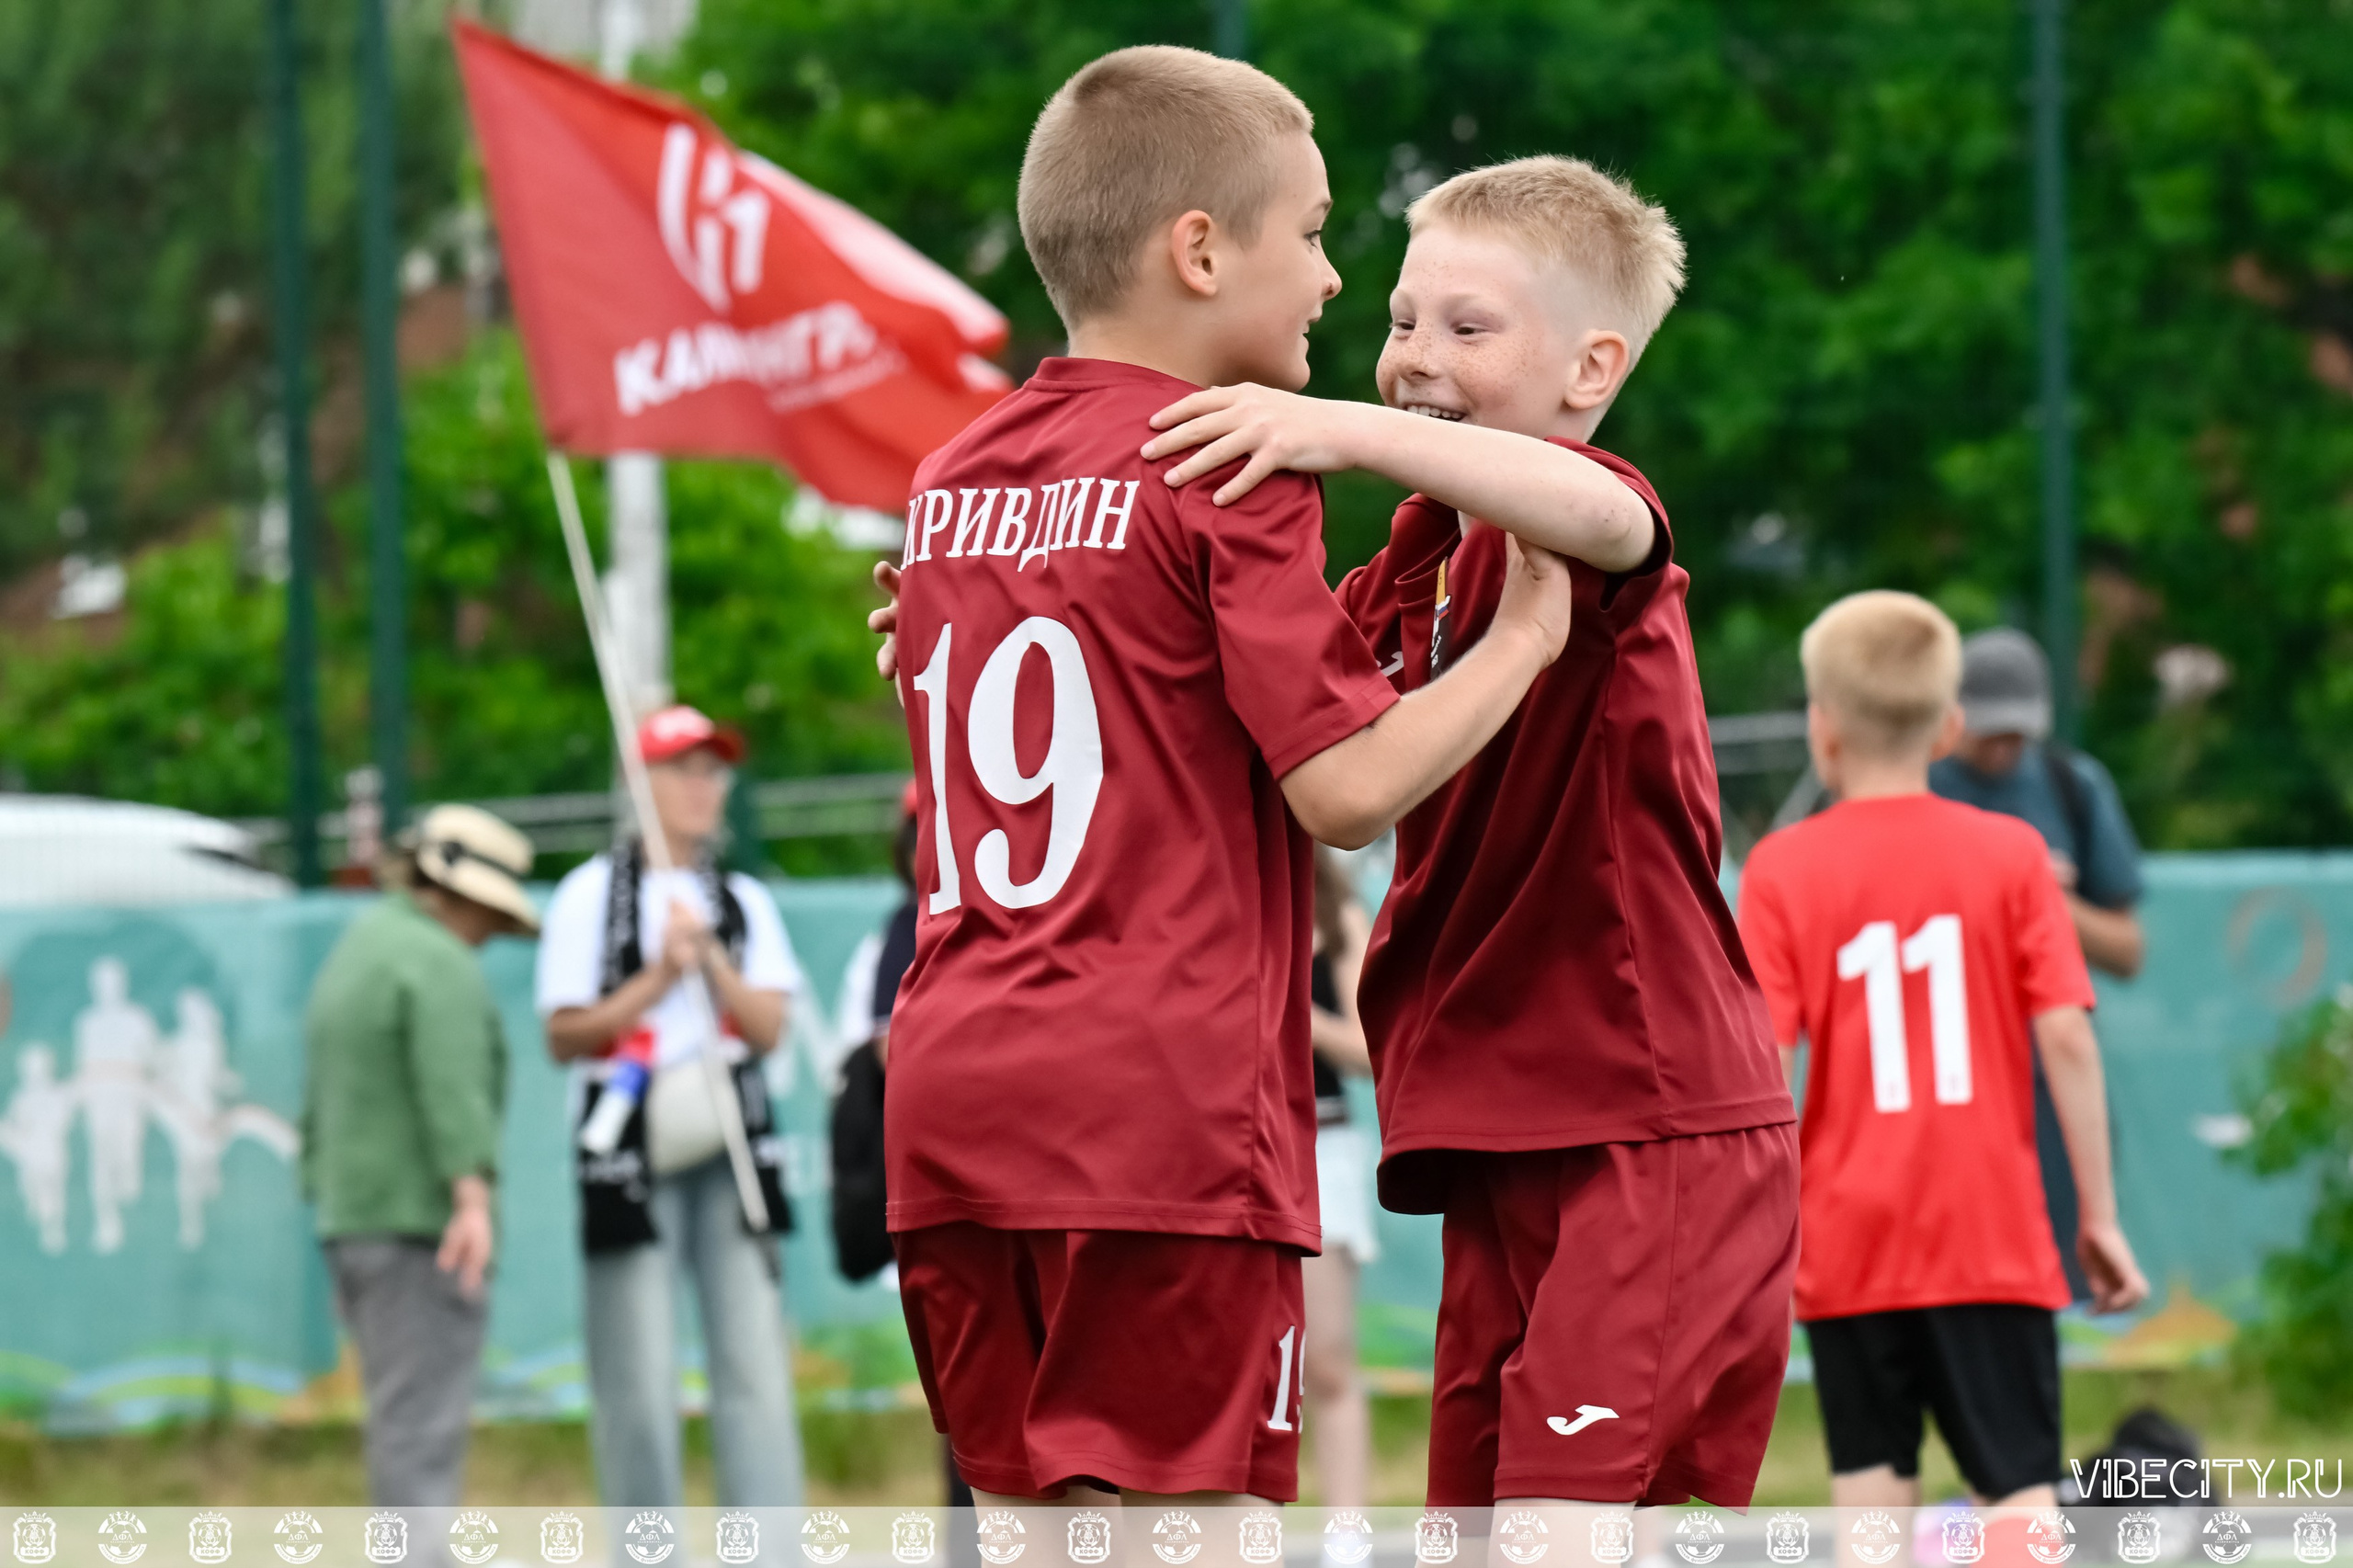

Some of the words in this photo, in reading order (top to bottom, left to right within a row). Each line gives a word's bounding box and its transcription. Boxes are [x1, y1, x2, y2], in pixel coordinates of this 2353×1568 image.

[914, 616, 1104, 915] 19
[1836, 914, 1973, 1115] 11
[1267, 1325, 1306, 1434] 1
